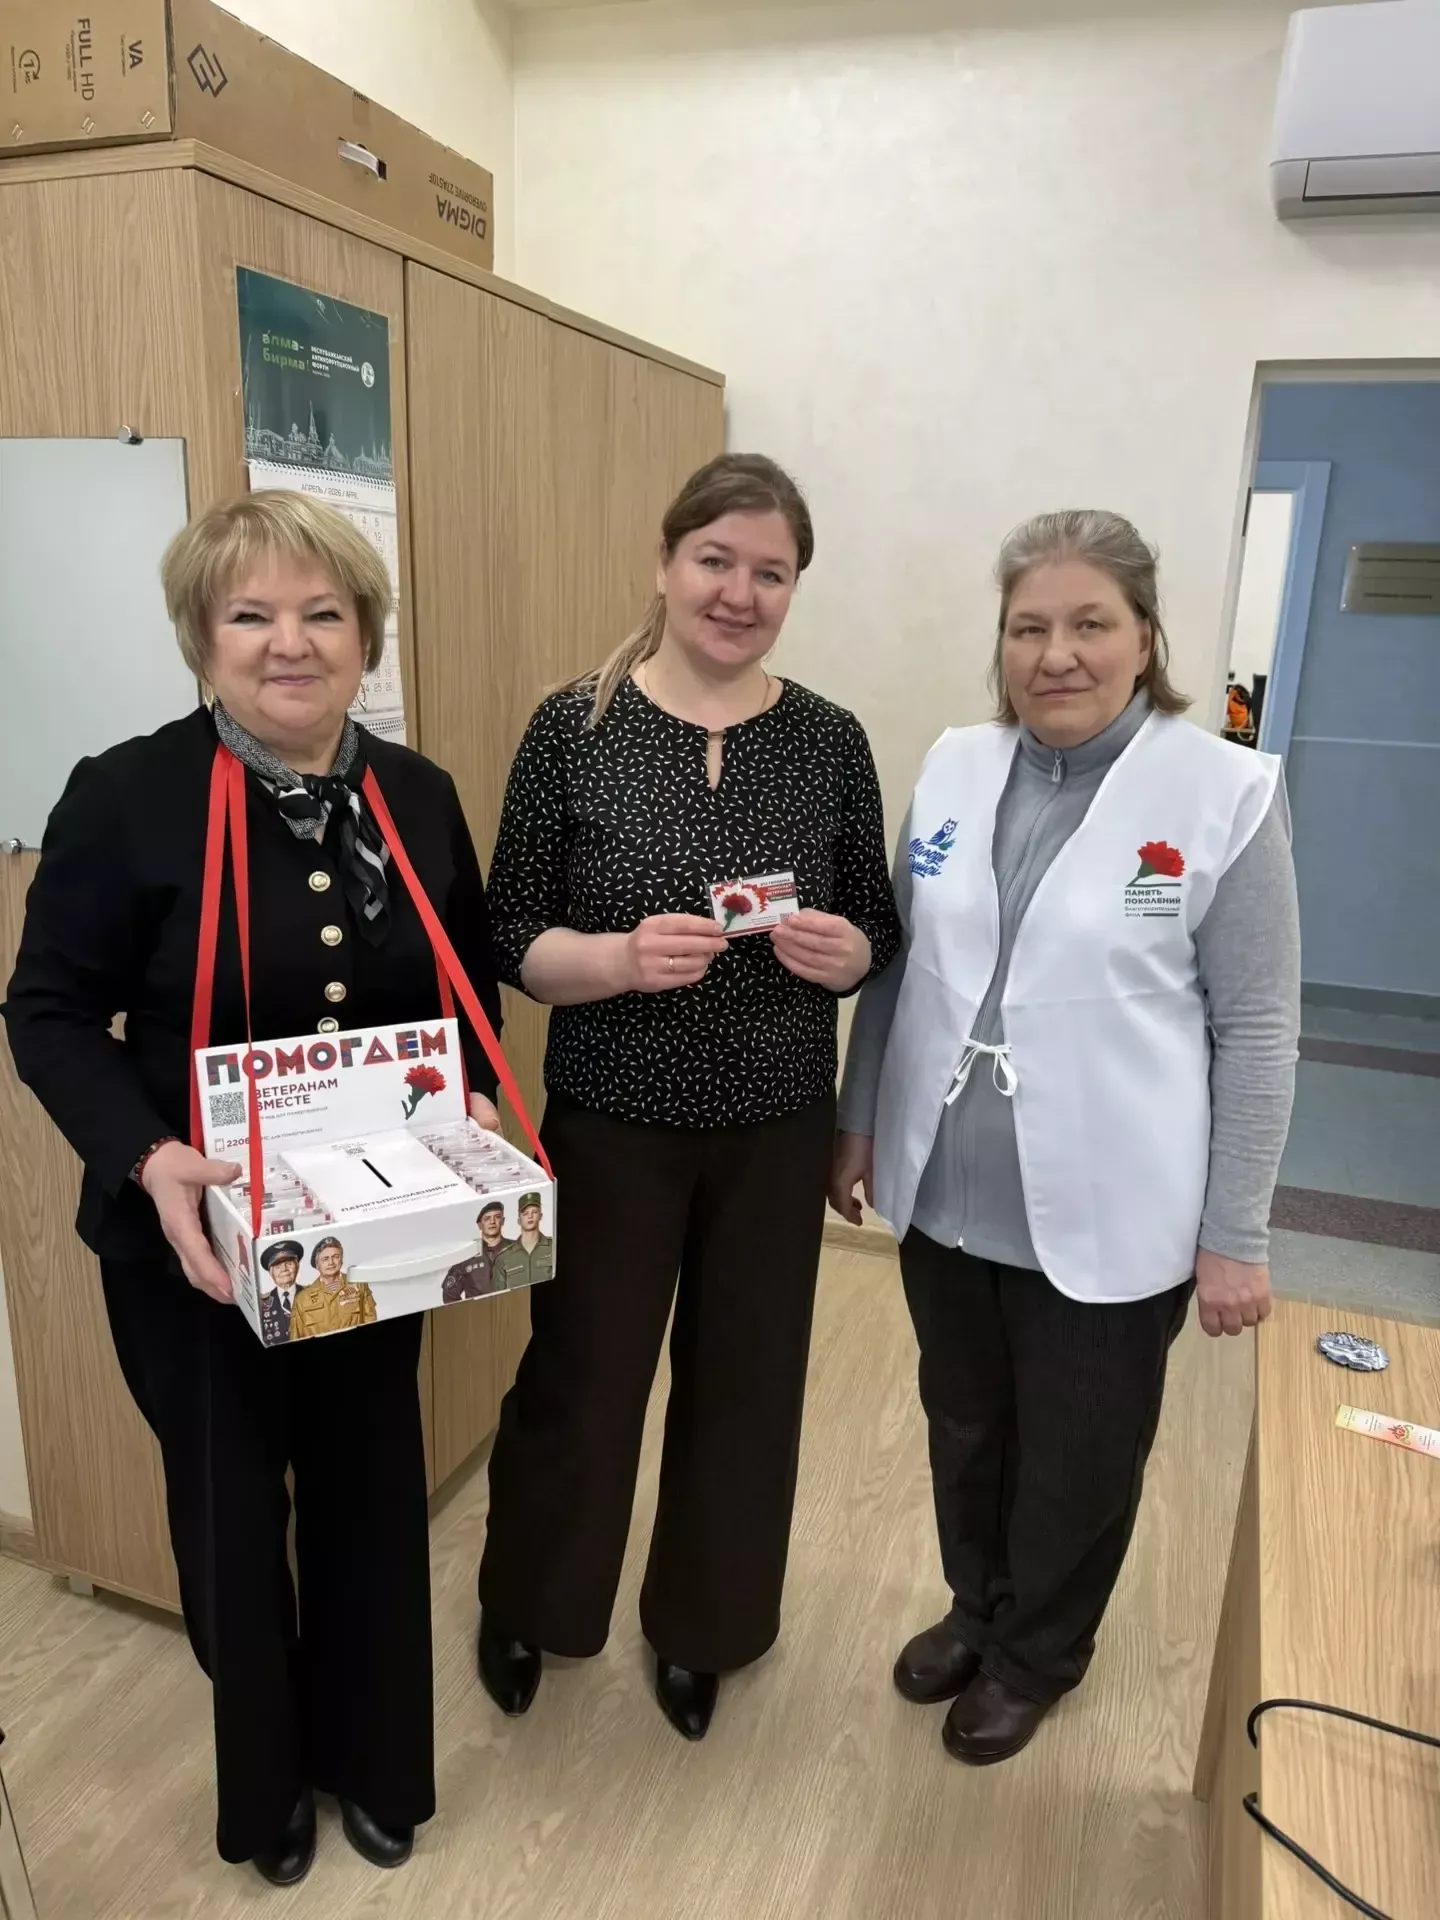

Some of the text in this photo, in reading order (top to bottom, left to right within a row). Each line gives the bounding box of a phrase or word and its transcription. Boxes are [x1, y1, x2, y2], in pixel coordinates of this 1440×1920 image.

[77, 18, 95, 101] FULL HD
[128, 40, 143, 70] VA
[455, 185, 488, 213] OVERDRIVE
[436, 194, 487, 240] DIGMA
[301, 483, 323, 494] АПРЕЛЬ
[328, 487, 342, 497] 2026
[346, 490, 360, 500] APRIL
[374, 682, 382, 693] 25
[1124, 896, 1181, 905] ПОКОЛЕНИЙ
